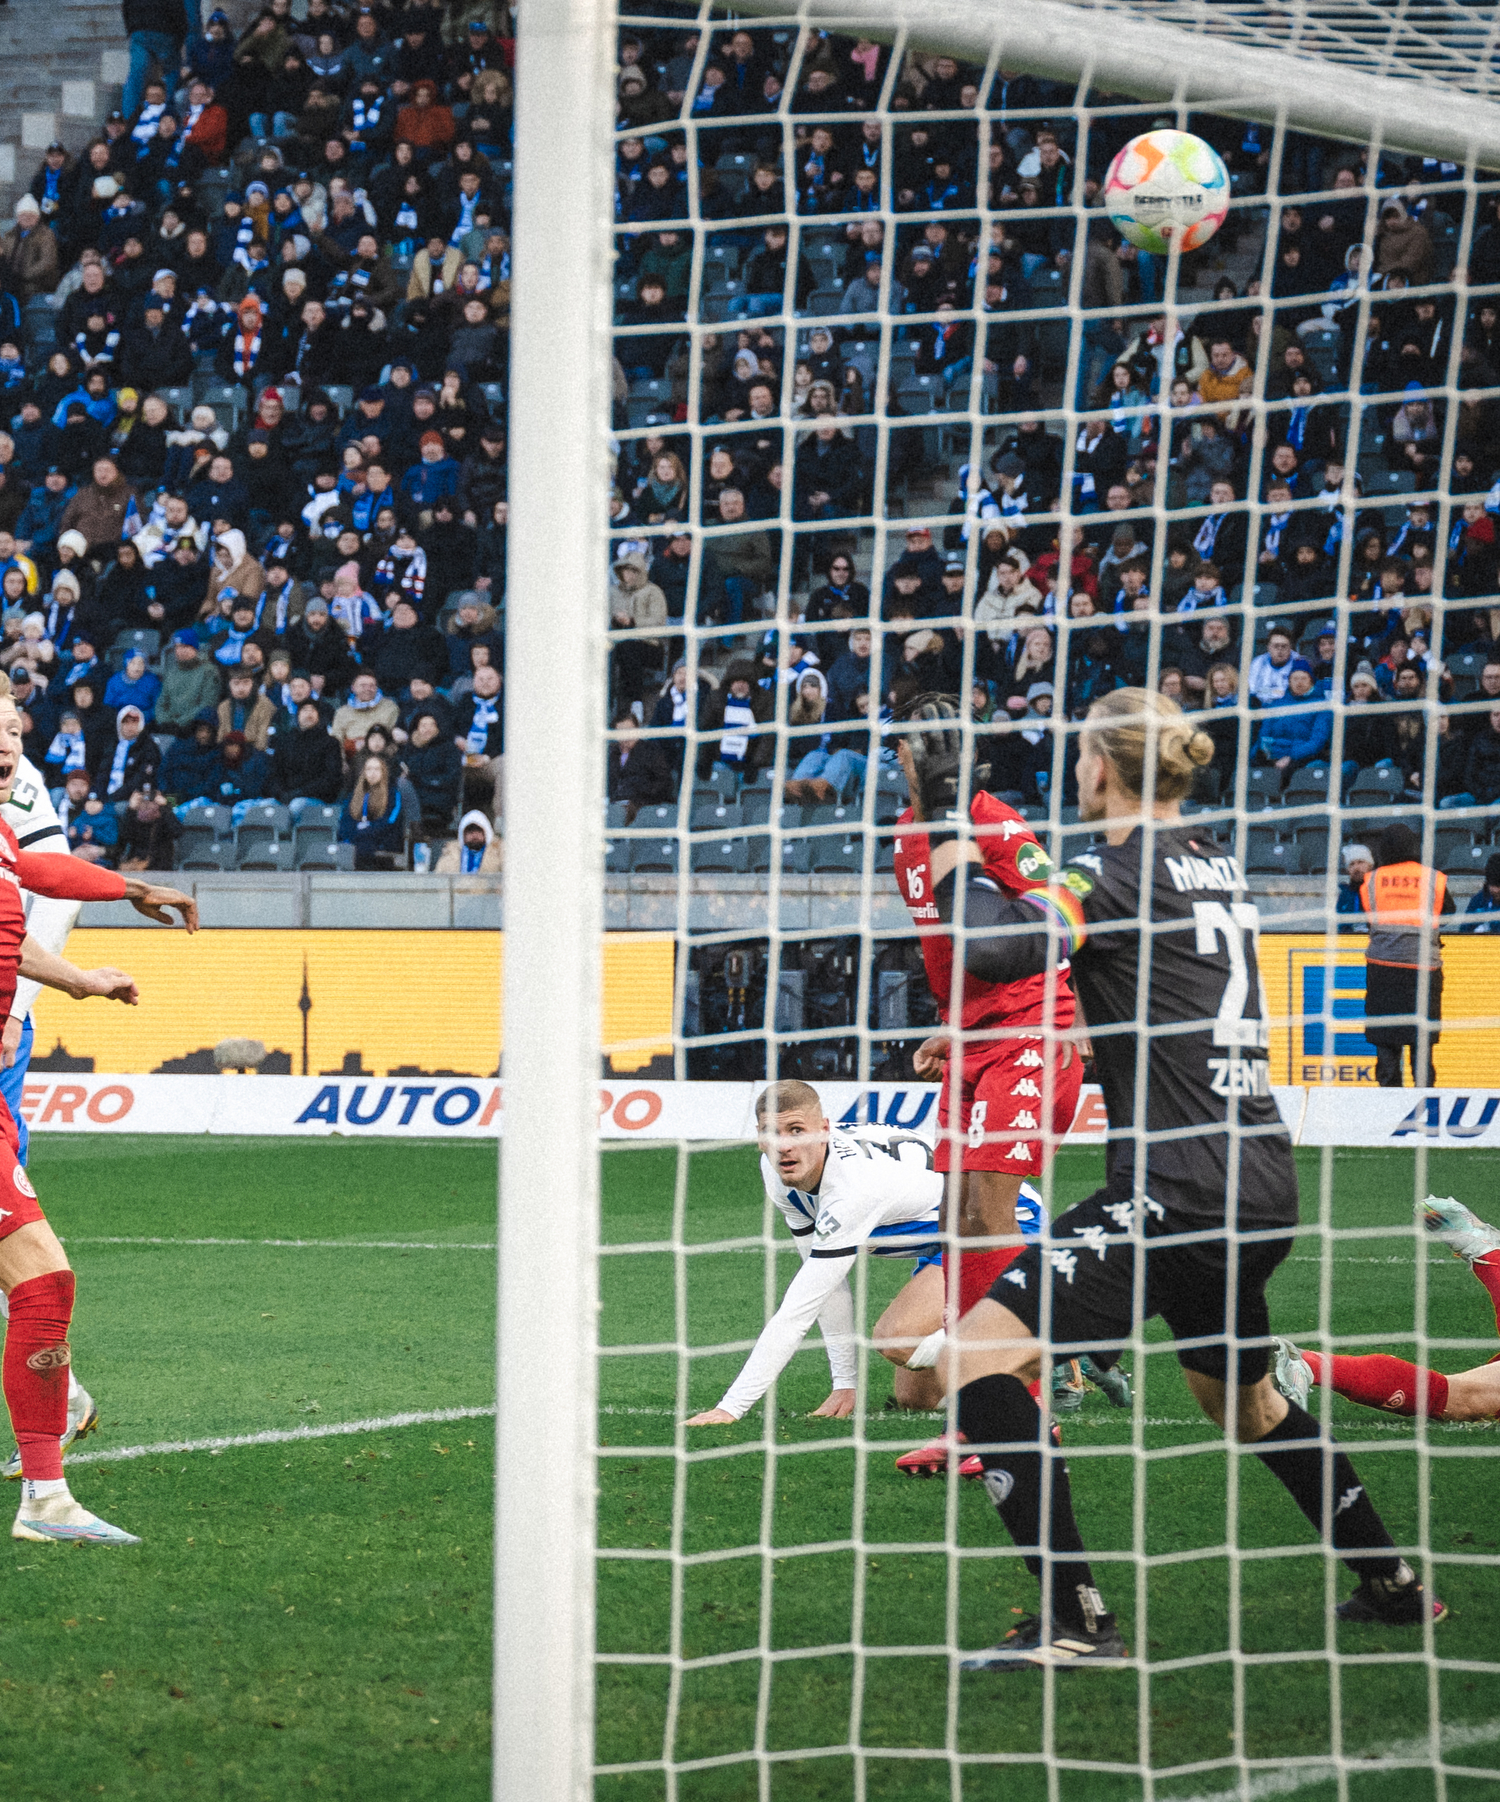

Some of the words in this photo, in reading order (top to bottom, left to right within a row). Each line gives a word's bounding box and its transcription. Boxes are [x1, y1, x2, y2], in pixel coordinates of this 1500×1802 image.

[1381, 876, 1421, 888] BEST
[1302, 1065, 1375, 1082] EDEK
[967, 1100, 988, 1149] 8
